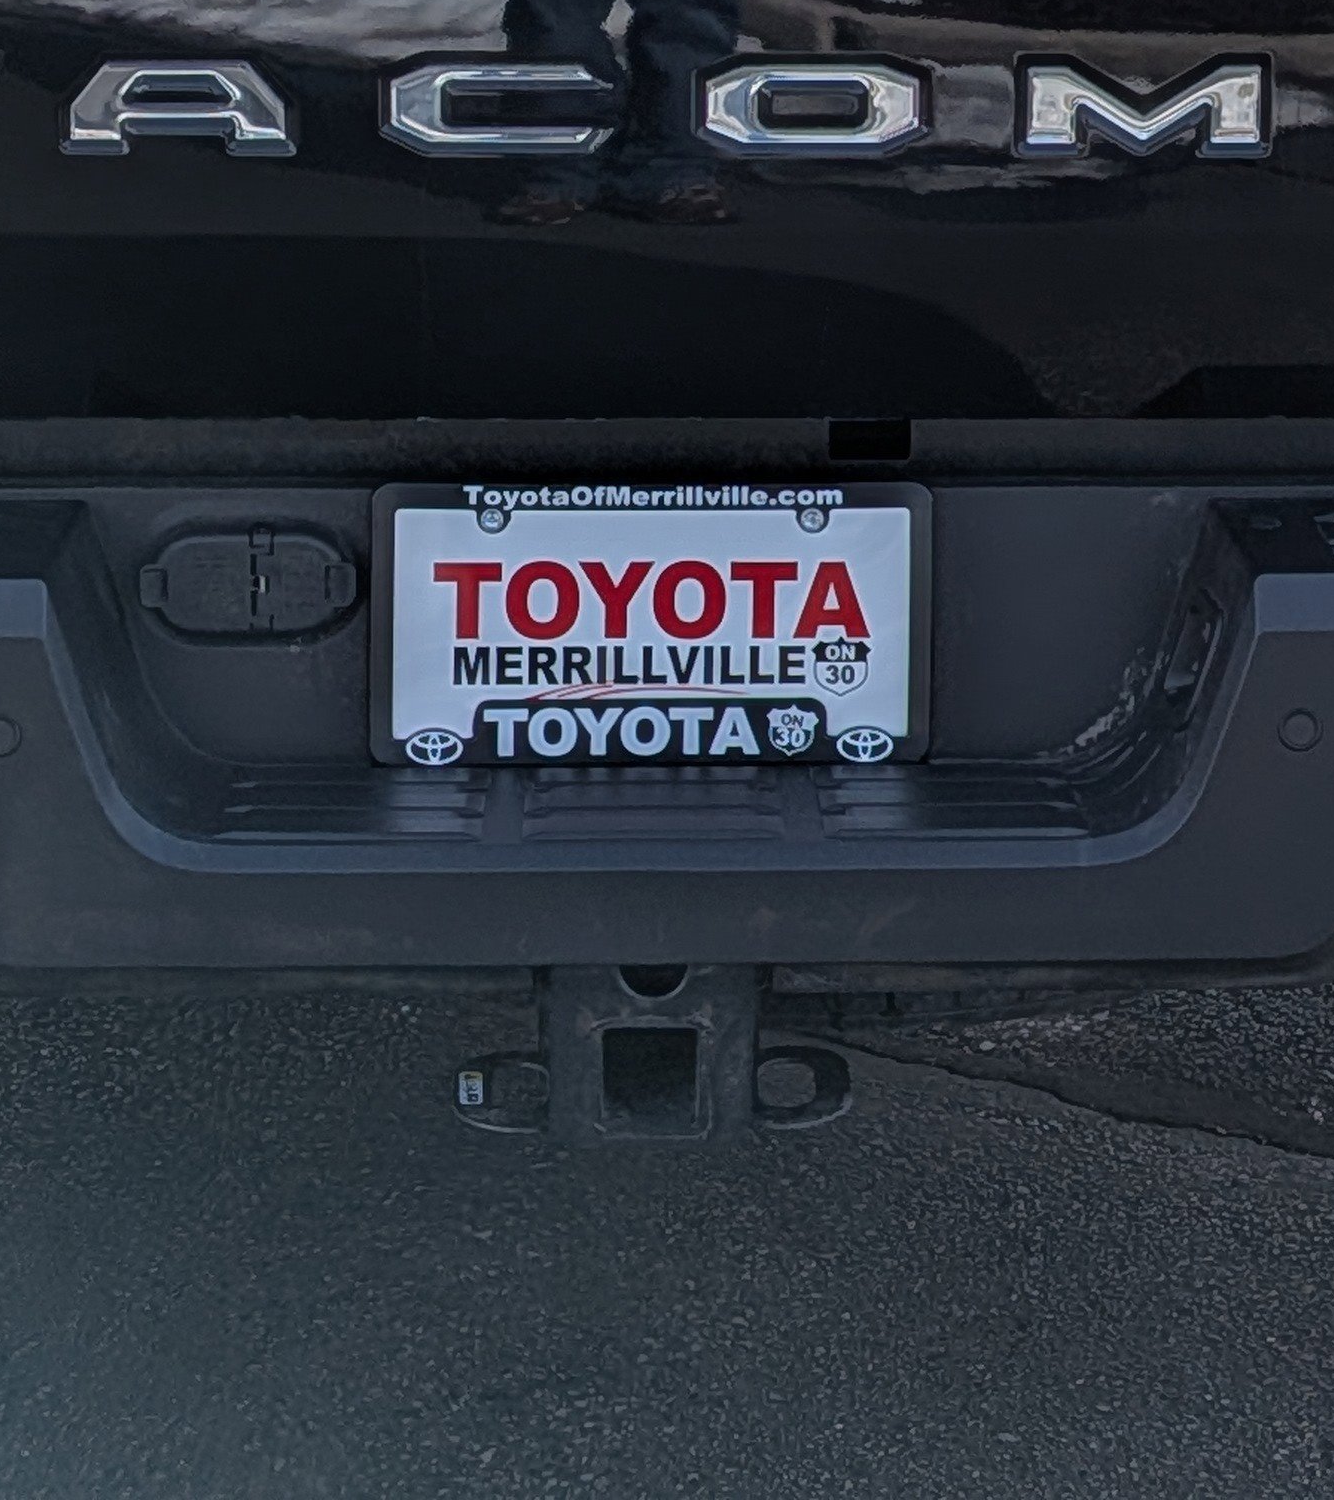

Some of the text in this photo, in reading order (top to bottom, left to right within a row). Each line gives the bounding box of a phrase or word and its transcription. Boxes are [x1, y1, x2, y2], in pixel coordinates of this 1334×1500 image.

[463, 486, 844, 510] ToyotaOfMerrillville.com
[433, 560, 870, 640] TOYOTA
[825, 644, 857, 661] ON
[452, 645, 807, 686] MERRILLVILLE
[825, 664, 856, 685] 30
[482, 706, 761, 757] TOYOTA
[780, 713, 805, 729] ON
[774, 726, 806, 749] 30
